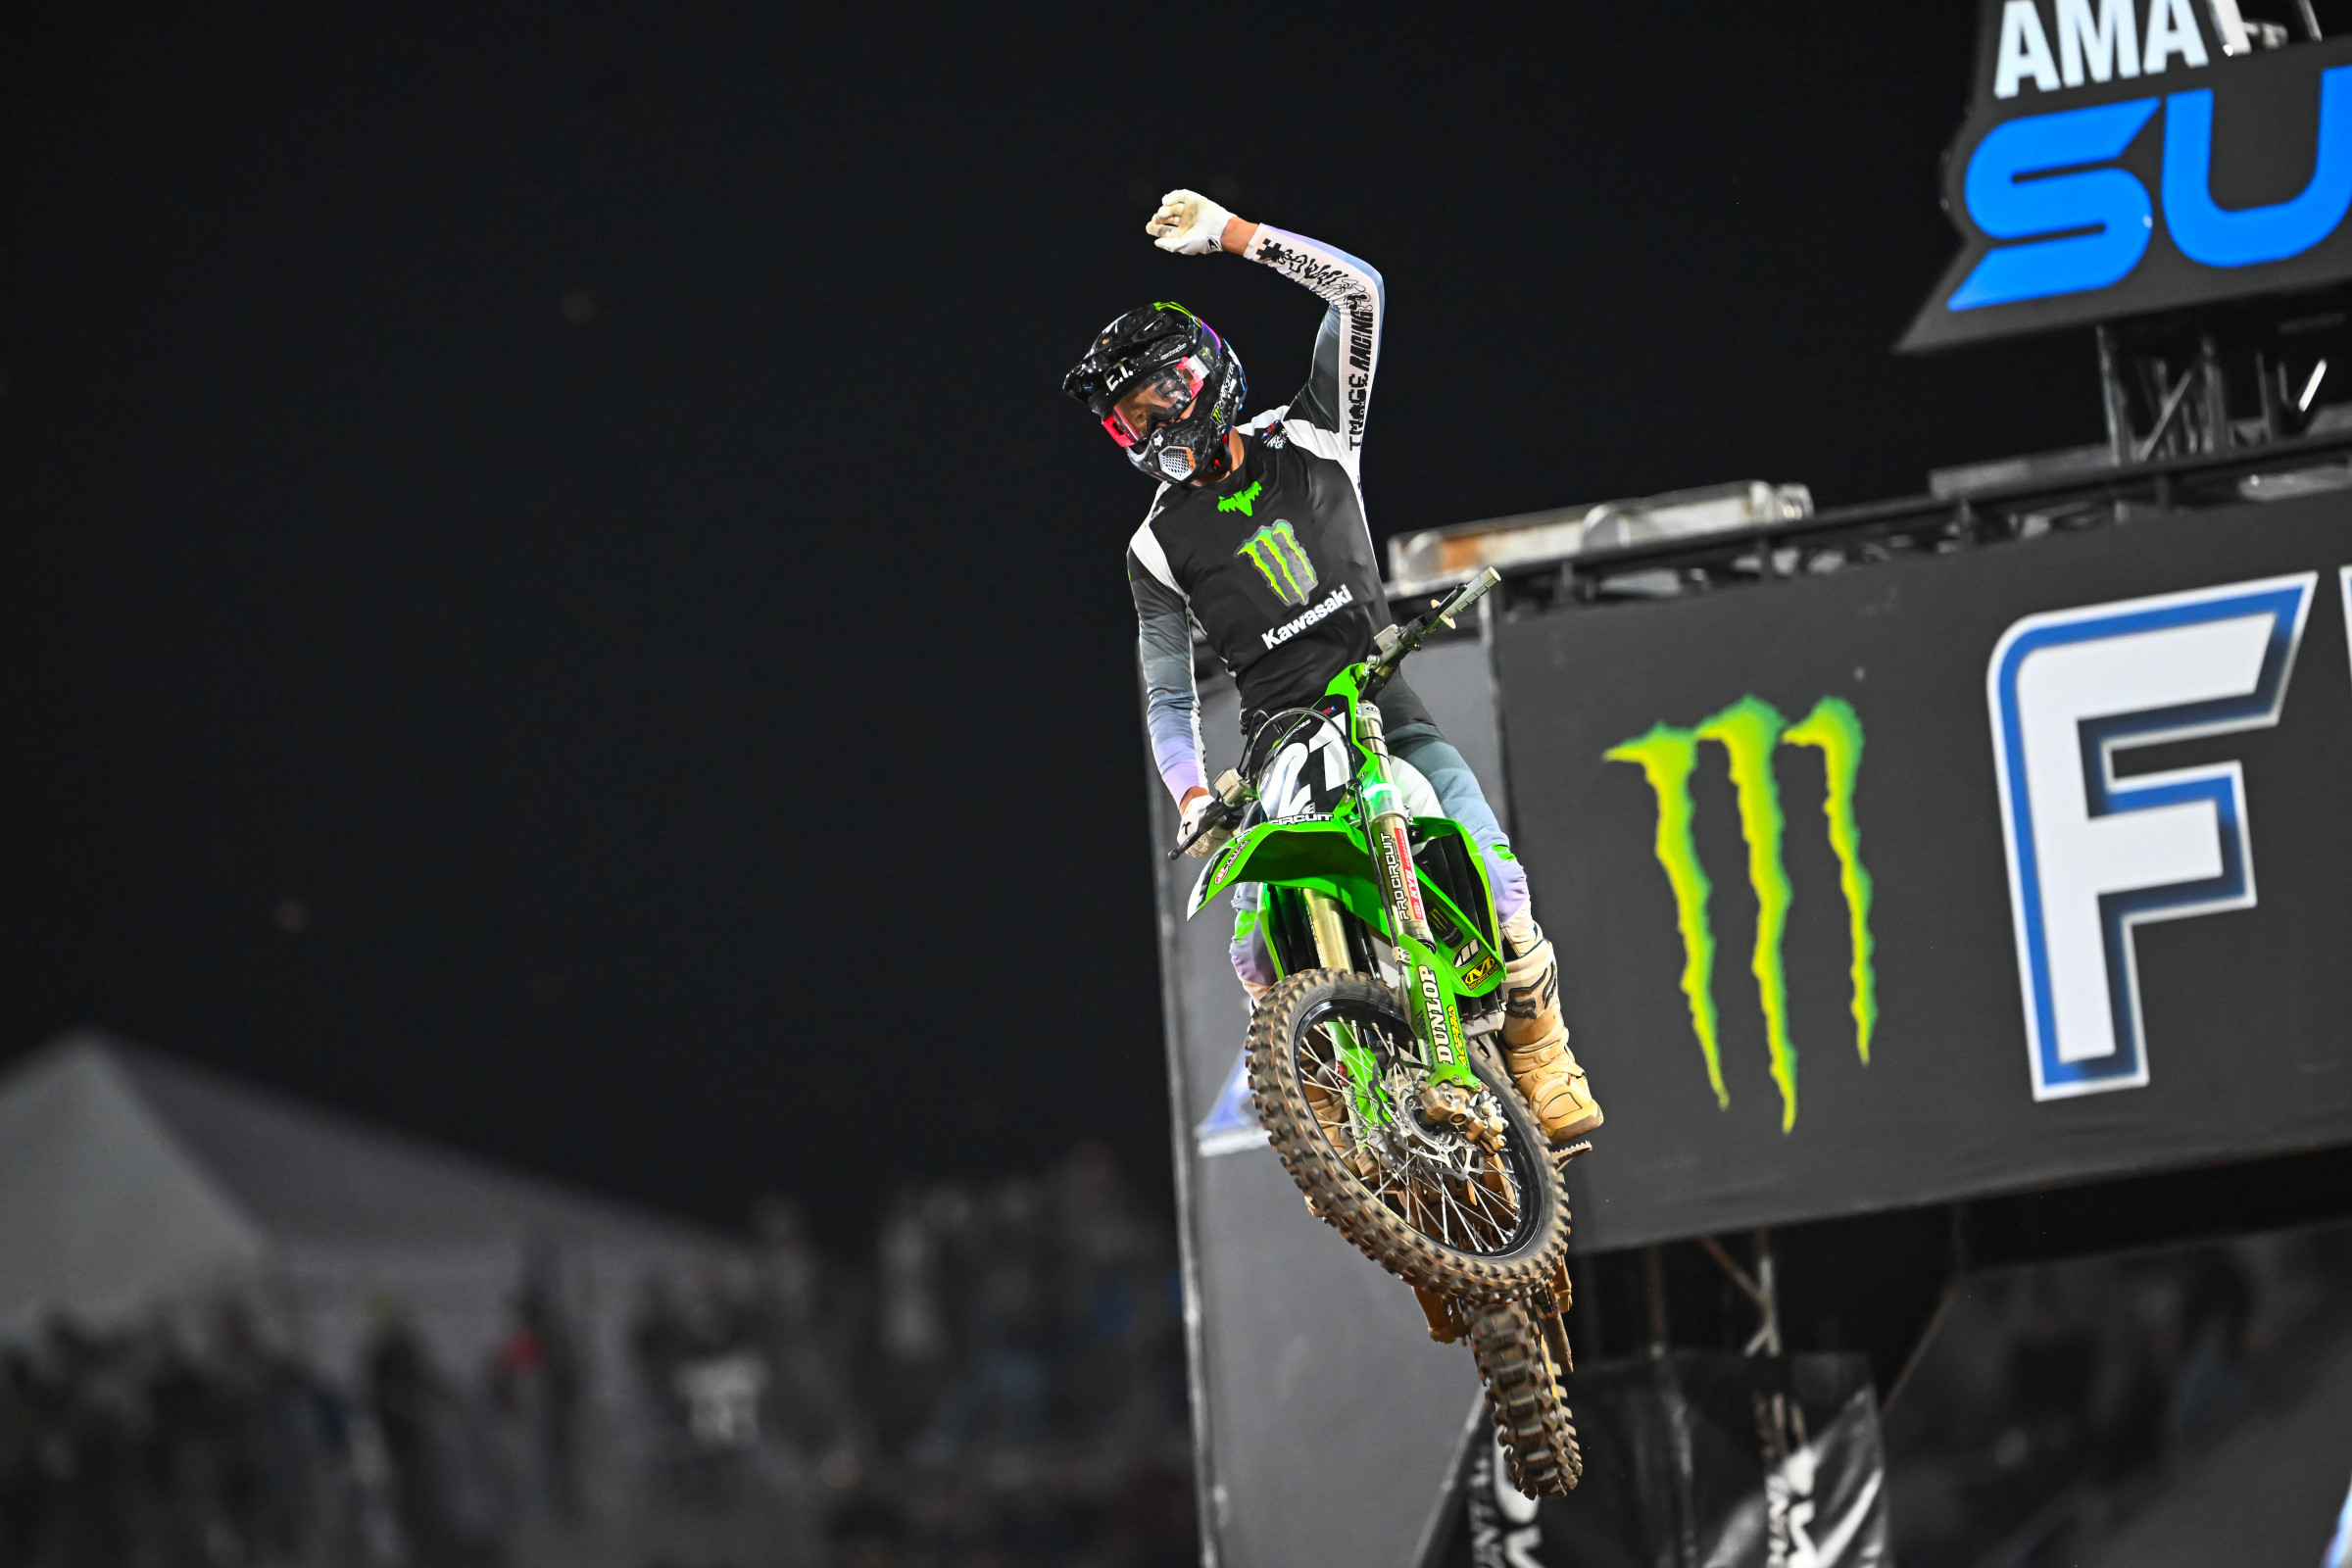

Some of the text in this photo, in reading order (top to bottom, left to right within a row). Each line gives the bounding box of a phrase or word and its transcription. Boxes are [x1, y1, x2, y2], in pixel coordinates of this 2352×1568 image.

[1994, 0, 2209, 98] AMA
[1947, 66, 2352, 311] SU
[1349, 309, 1373, 371] RACING
[1261, 584, 1353, 650] Kawasaki
[1268, 813, 1334, 825] CIRCUIT
[1986, 565, 2352, 1102] F
[1380, 832, 1410, 921] PRO CIRCUIT
[1418, 964, 1455, 1065] DUNLOP
